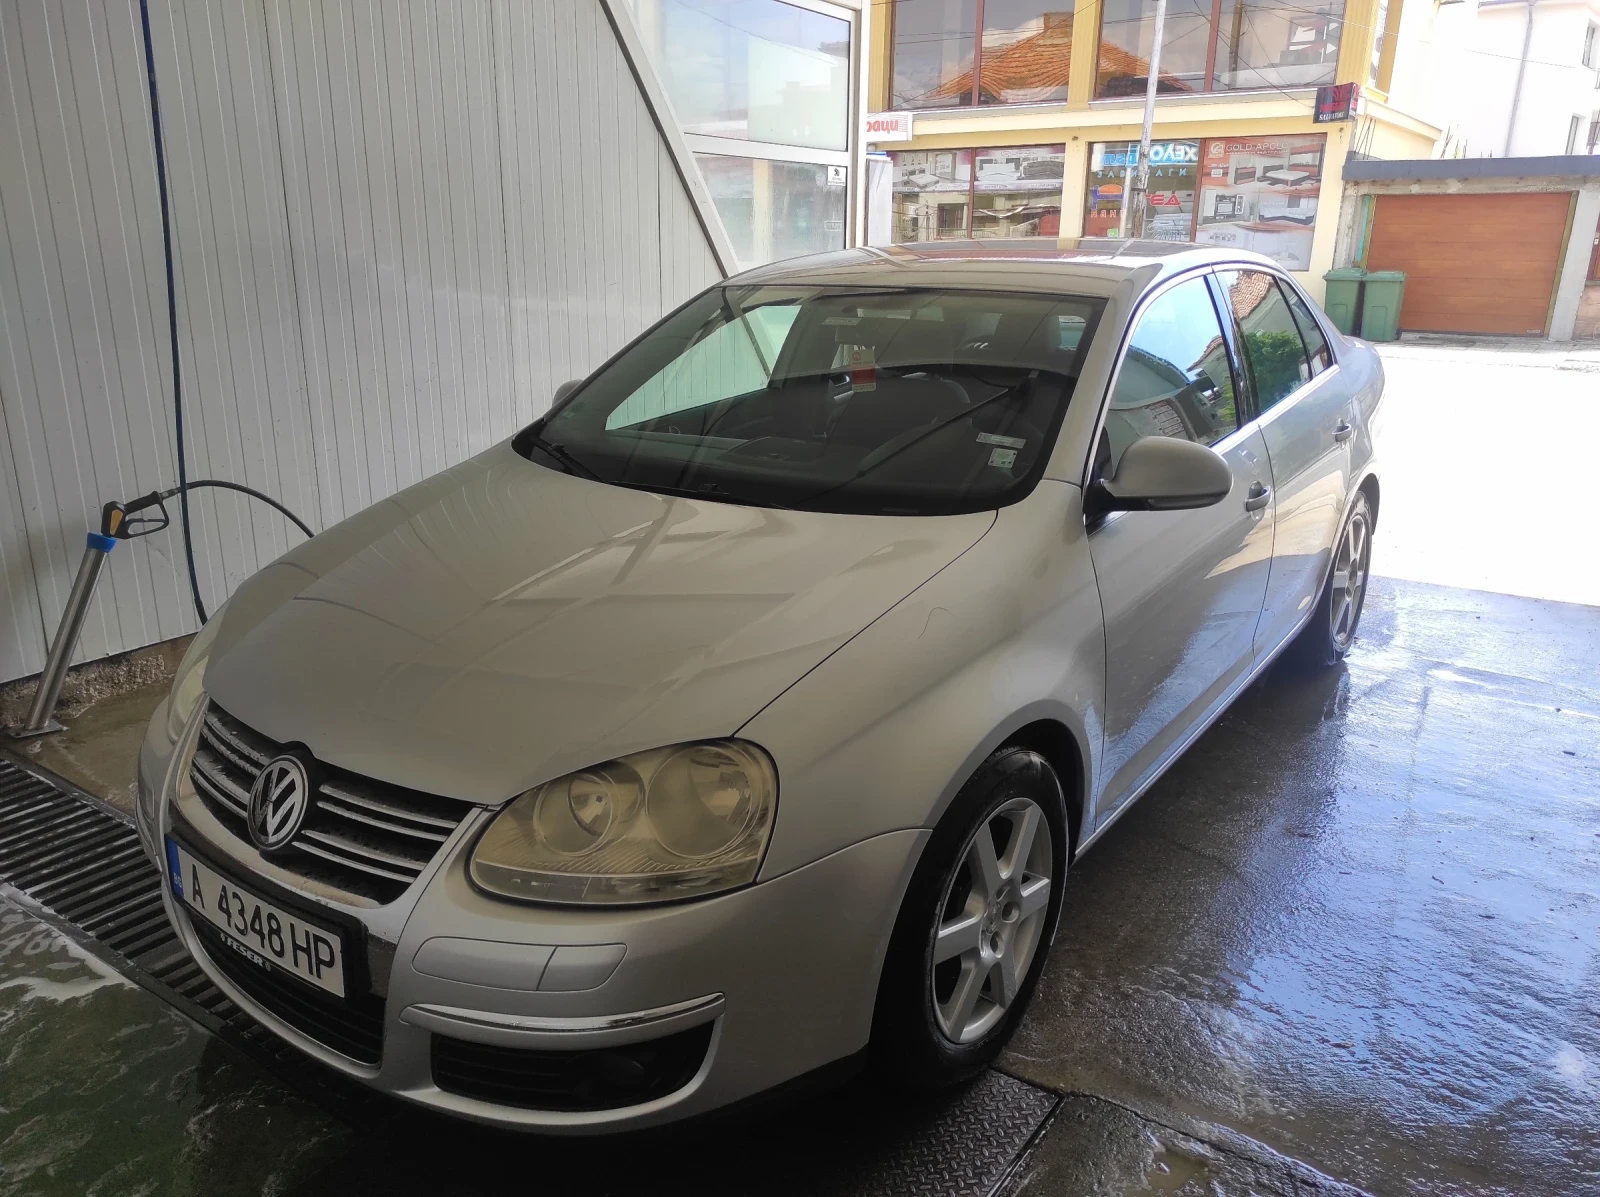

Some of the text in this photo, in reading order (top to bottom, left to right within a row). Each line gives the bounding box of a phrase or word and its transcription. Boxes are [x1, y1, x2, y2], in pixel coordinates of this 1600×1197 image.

[1225, 142, 1253, 152] GOLD
[191, 863, 336, 980] A 4348 HP
[226, 936, 265, 968] FESER
